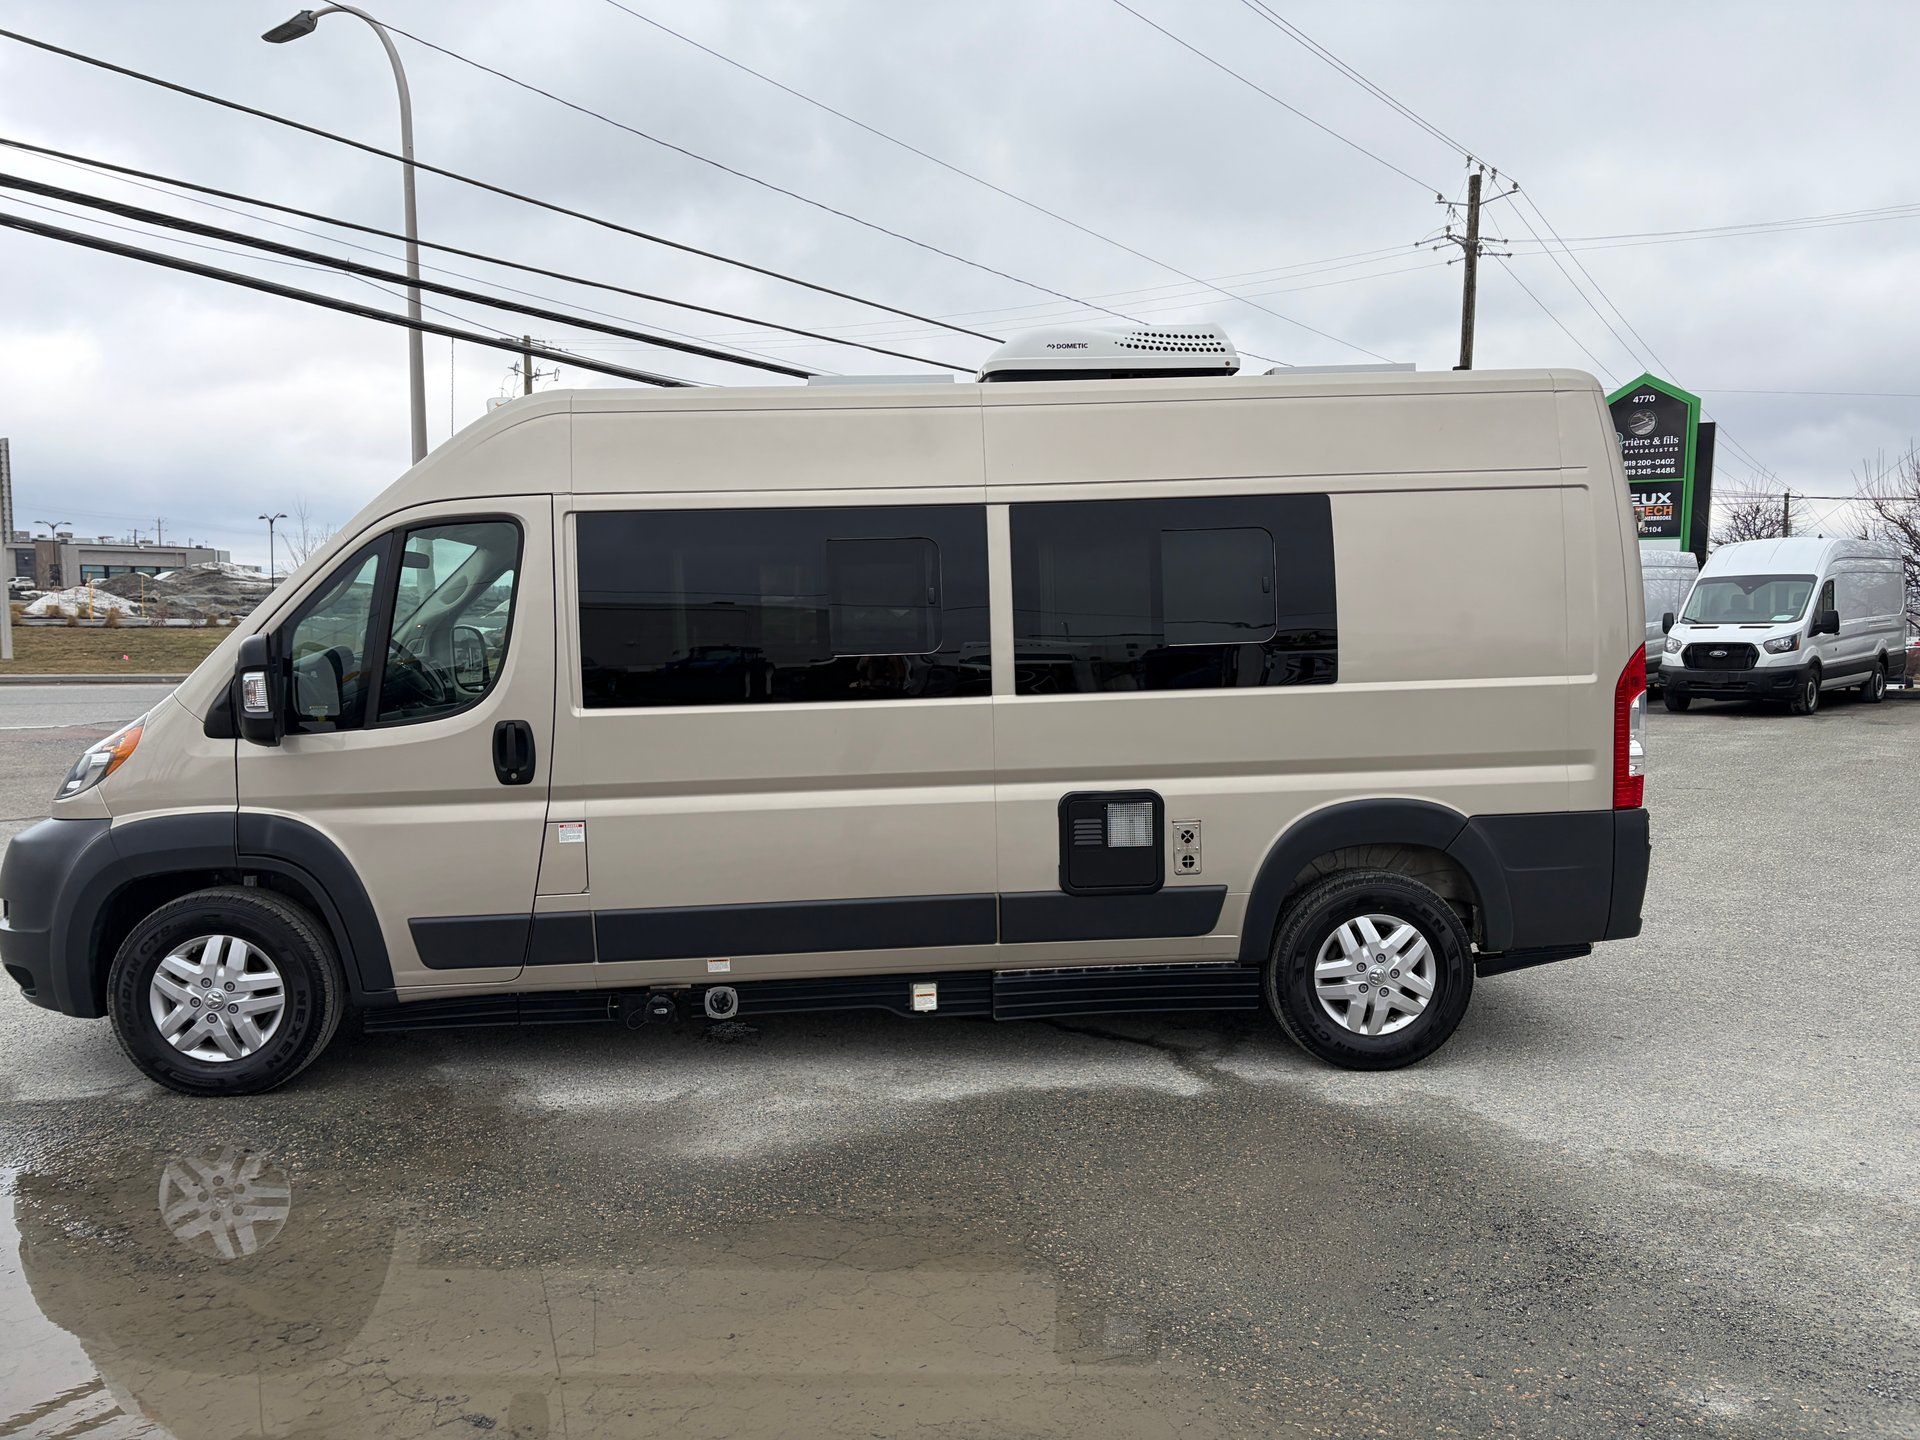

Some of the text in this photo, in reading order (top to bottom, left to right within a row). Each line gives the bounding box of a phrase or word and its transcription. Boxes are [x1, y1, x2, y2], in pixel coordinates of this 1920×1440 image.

[1056, 342, 1088, 350] DOMETIC
[1632, 394, 1656, 404] 4770
[1652, 436, 1661, 445] &
[1663, 435, 1679, 445] fils
[1637, 458, 1675, 466] 200-0402
[265, 989, 308, 1070] NEXEN
